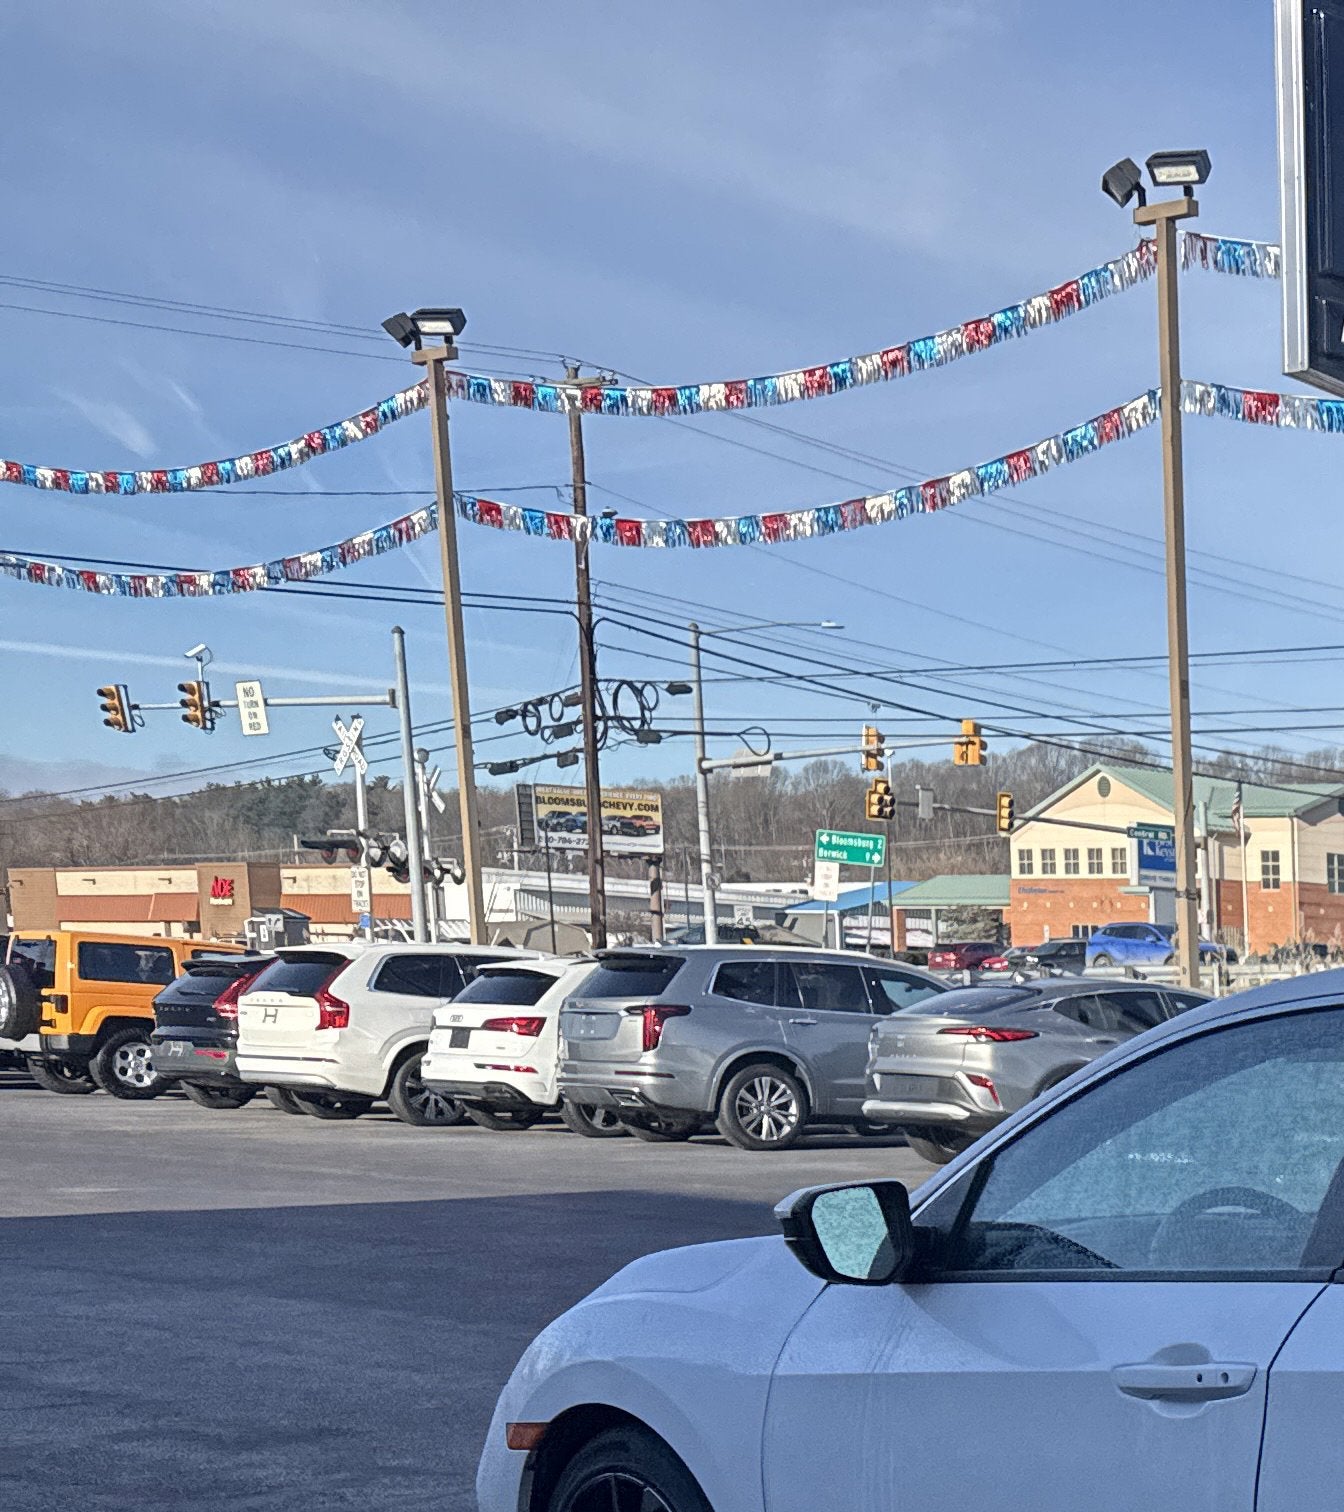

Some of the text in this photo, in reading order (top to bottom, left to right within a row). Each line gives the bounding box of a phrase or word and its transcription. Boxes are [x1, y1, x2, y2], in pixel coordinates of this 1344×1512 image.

[242, 686, 255, 698] NO
[248, 721, 262, 732] RED
[832, 834, 874, 850] Bloomsburg
